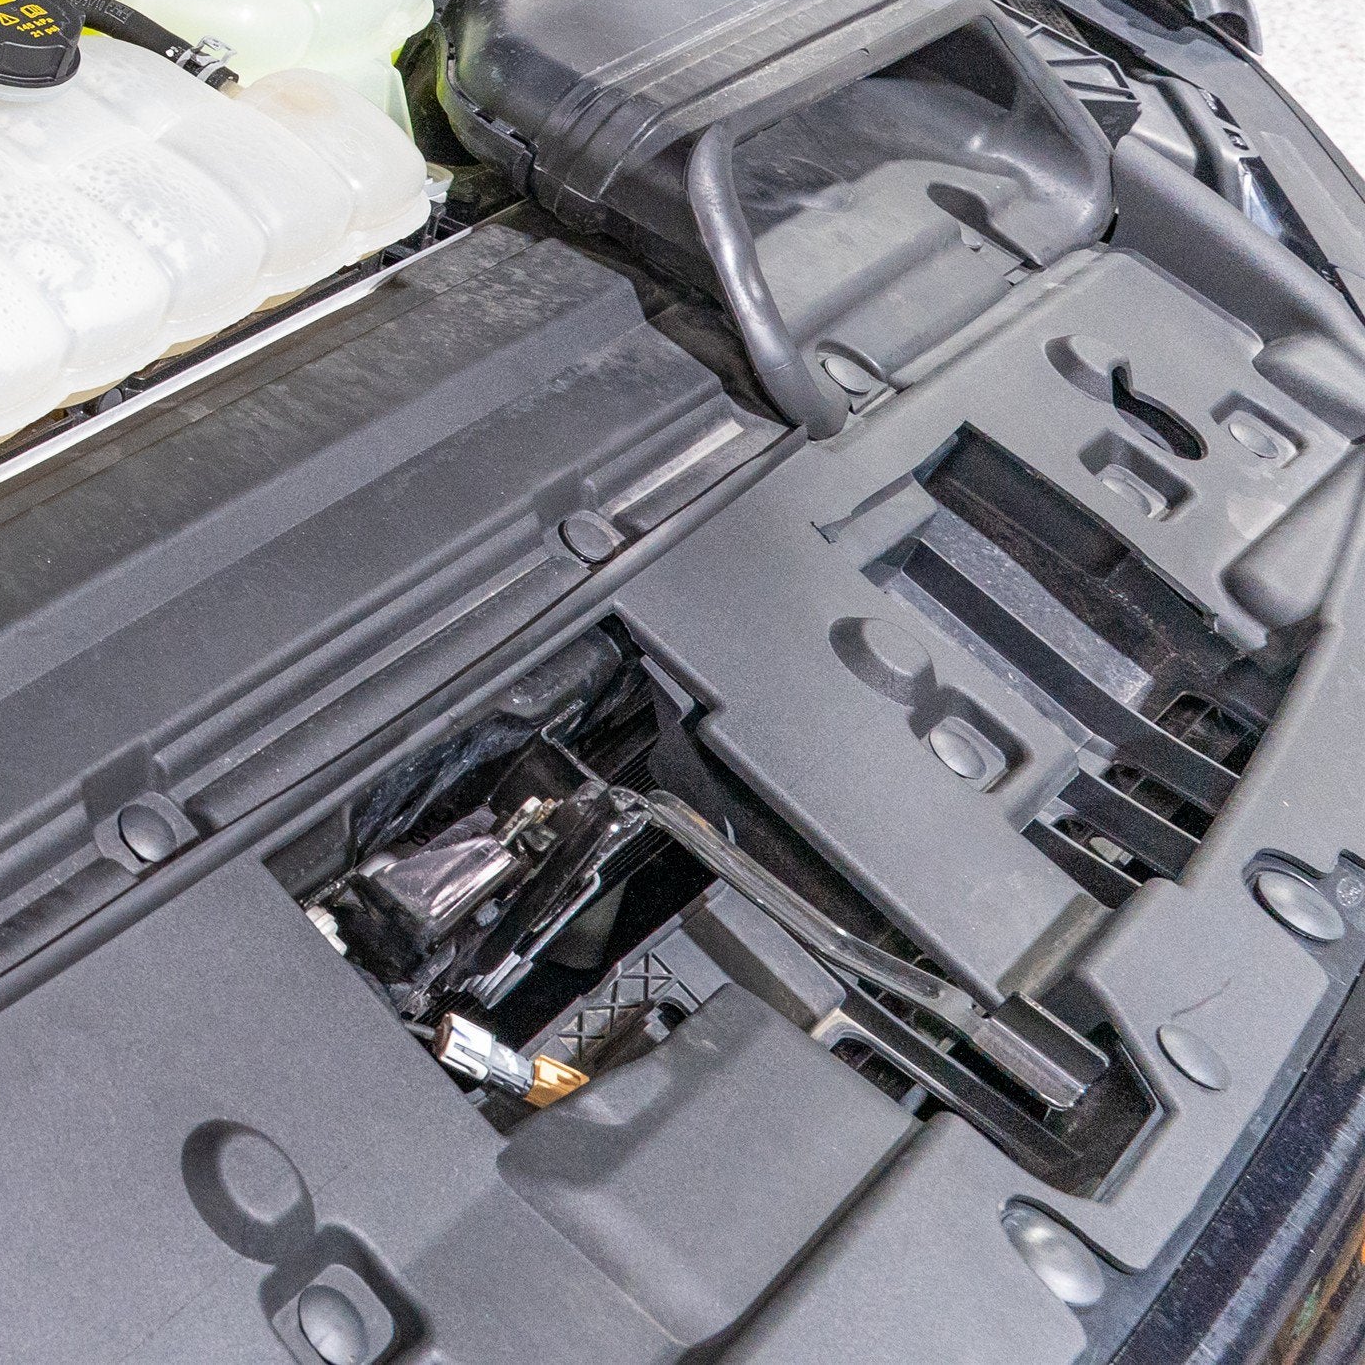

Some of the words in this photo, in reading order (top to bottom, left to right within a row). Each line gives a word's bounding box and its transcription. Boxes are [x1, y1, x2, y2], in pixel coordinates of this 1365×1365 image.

[17, 22, 35, 32] 145
[33, 17, 54, 27] kPa
[30, 30, 44, 38] 21
[45, 25, 60, 34] psi
